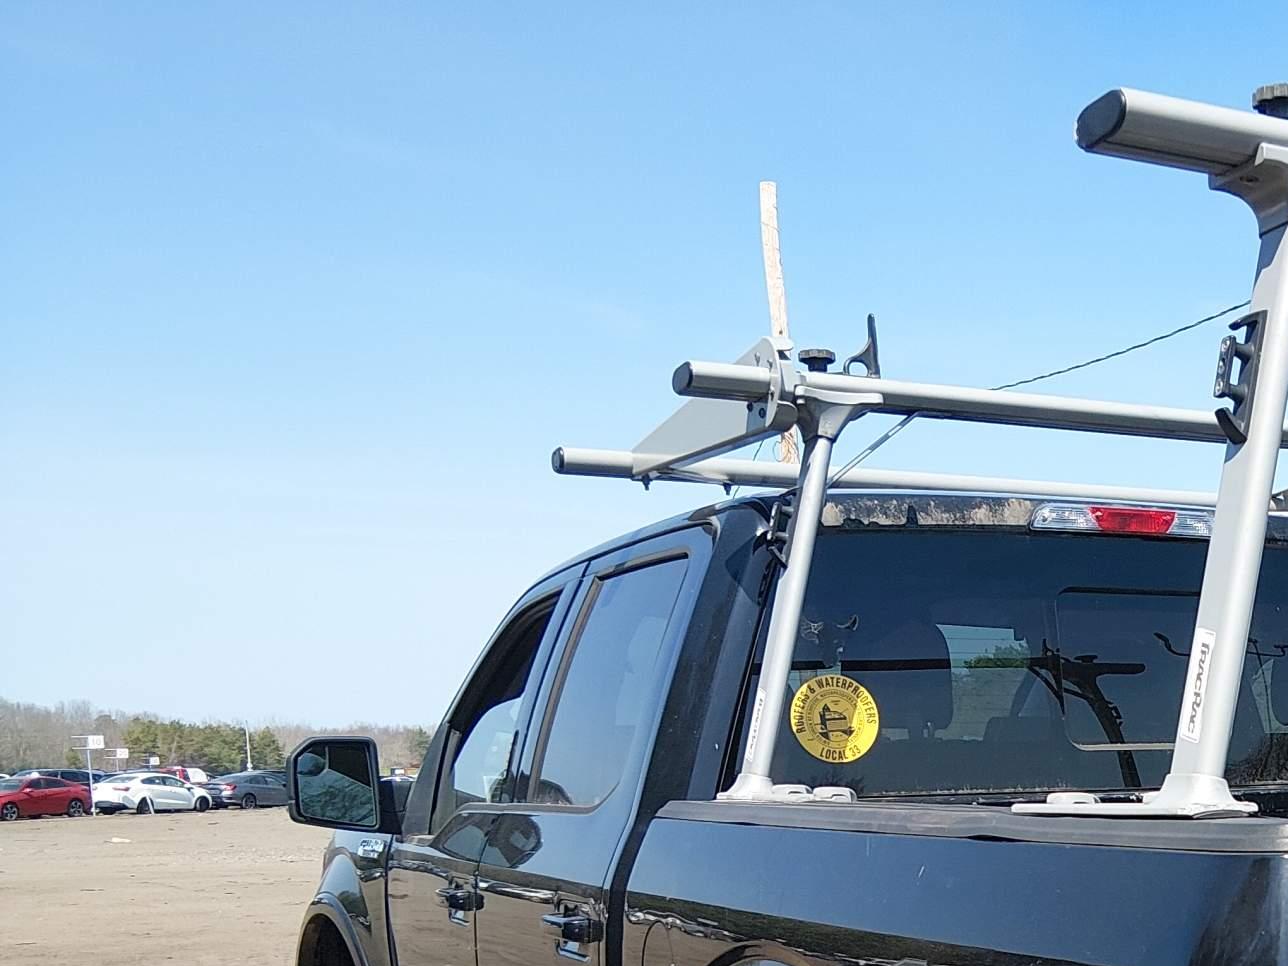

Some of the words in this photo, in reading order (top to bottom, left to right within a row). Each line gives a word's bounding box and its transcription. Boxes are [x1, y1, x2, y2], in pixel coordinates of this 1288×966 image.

[793, 690, 811, 734] ROOFERS
[806, 684, 816, 695] &
[815, 676, 877, 724] WATERPROOFERS
[820, 746, 848, 761] LOCAL
